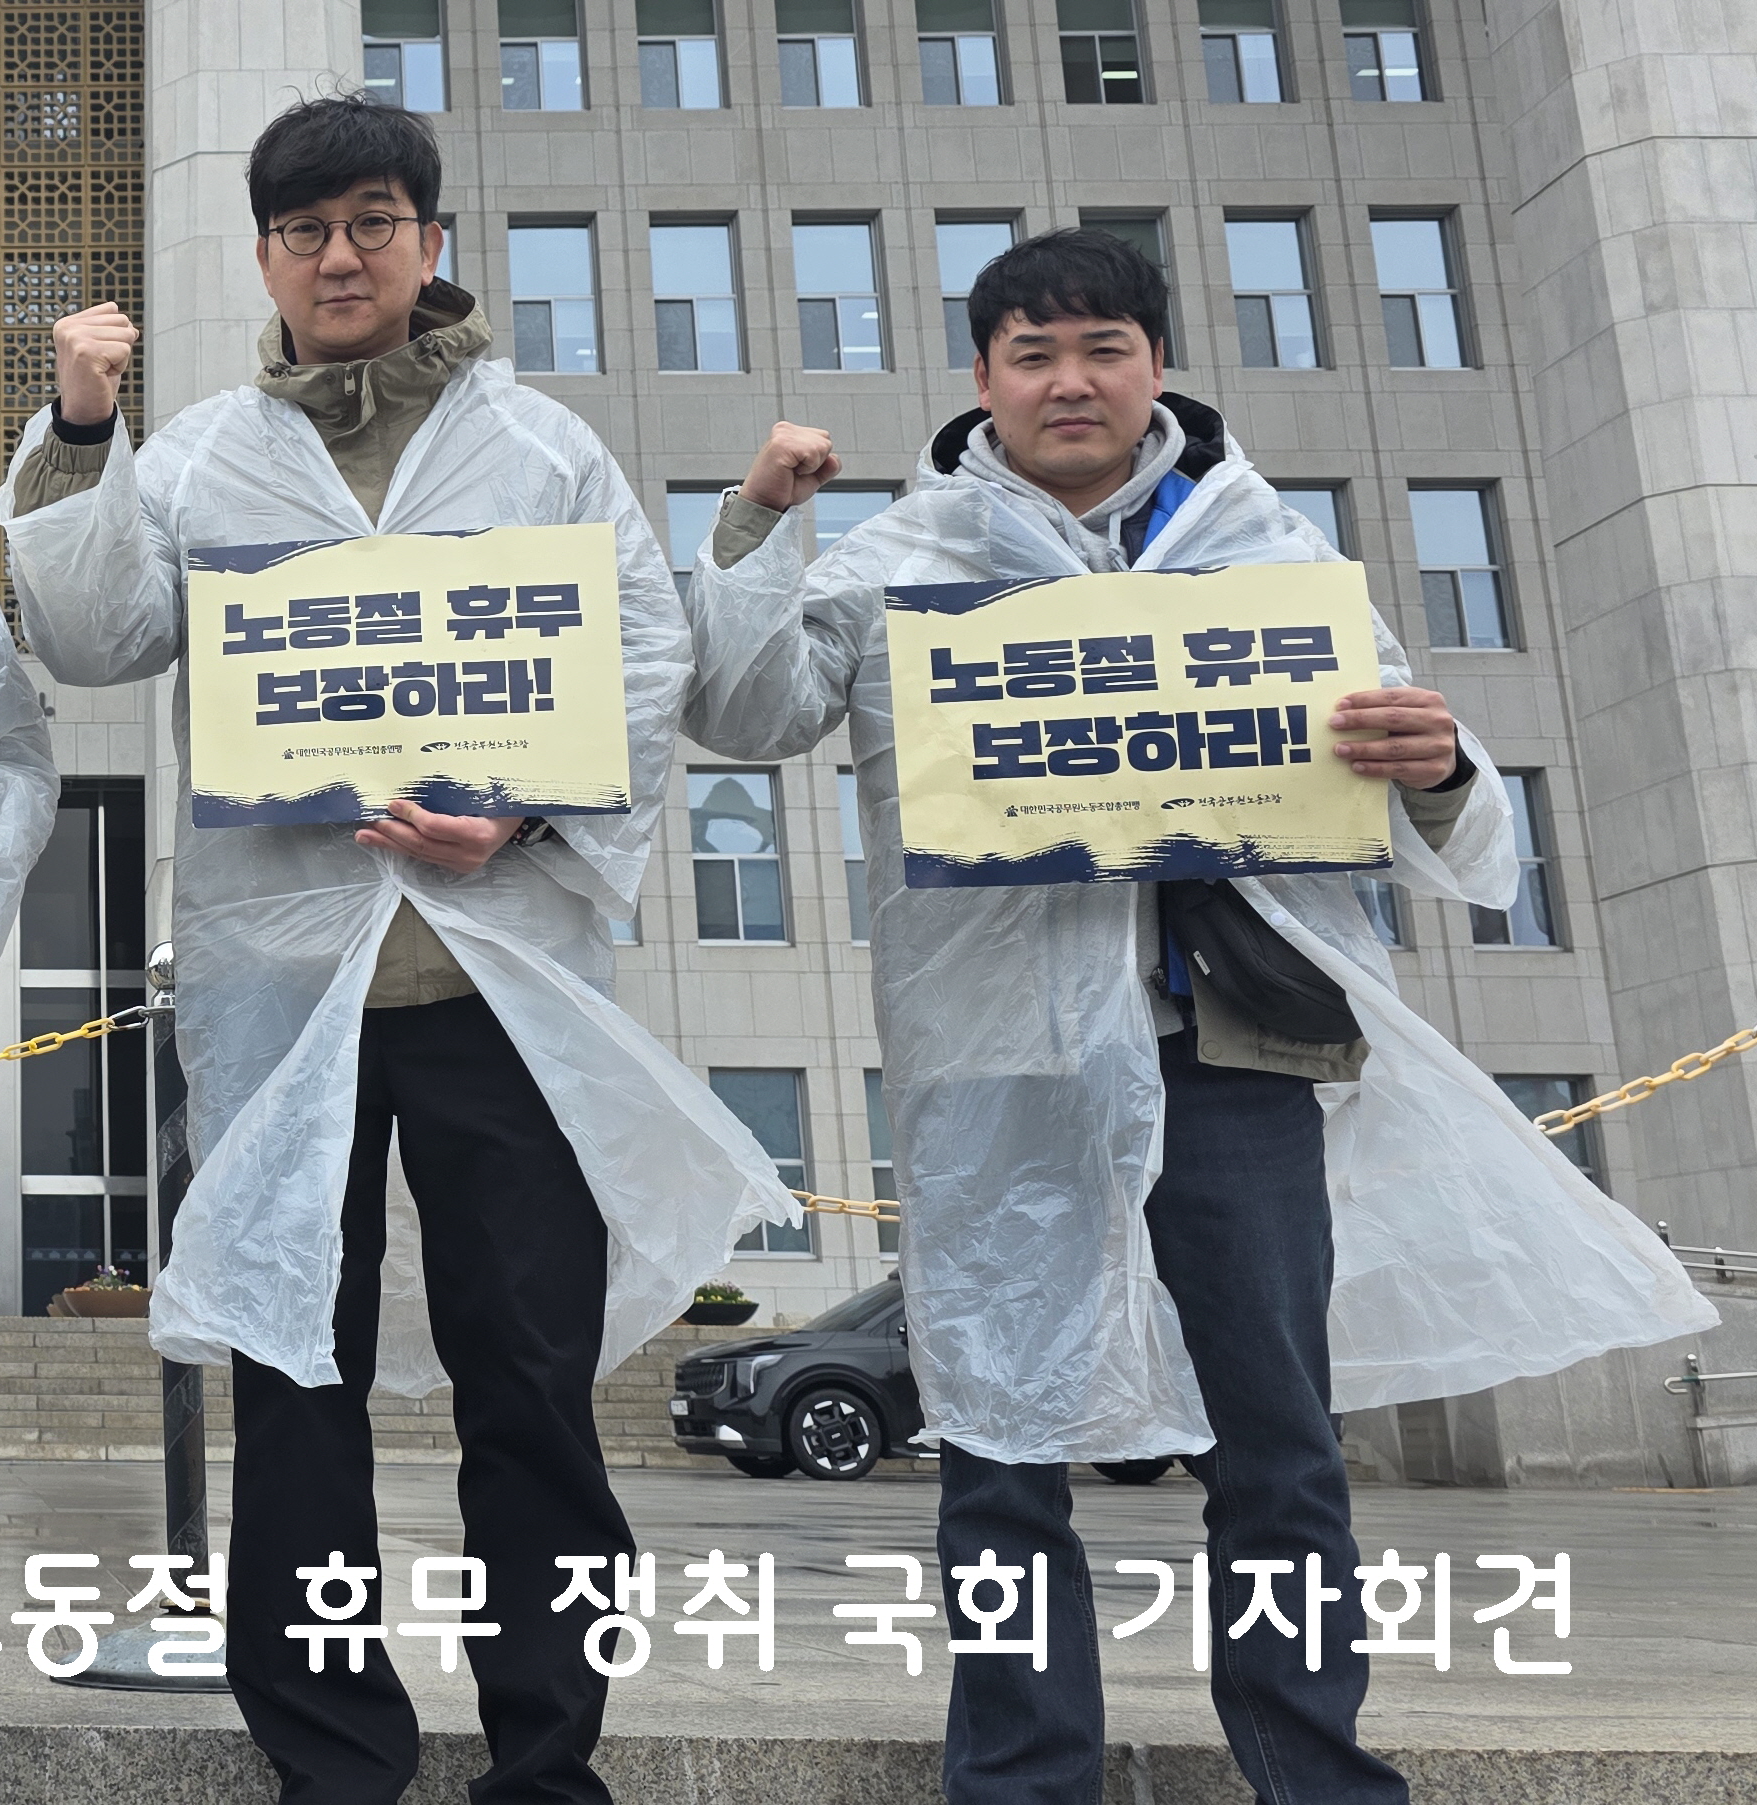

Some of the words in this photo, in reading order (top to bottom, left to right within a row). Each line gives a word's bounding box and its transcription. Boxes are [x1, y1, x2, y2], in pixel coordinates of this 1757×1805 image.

[223, 590, 423, 655] 노동절
[446, 583, 583, 641] 휴무
[255, 657, 555, 726] 보장하라!
[930, 634, 1159, 704] 노동절
[1182, 625, 1339, 688] 휴무
[972, 704, 1312, 781] 보장하라!
[1020, 800, 1141, 815] 대한민국공무원노동조합총연맹
